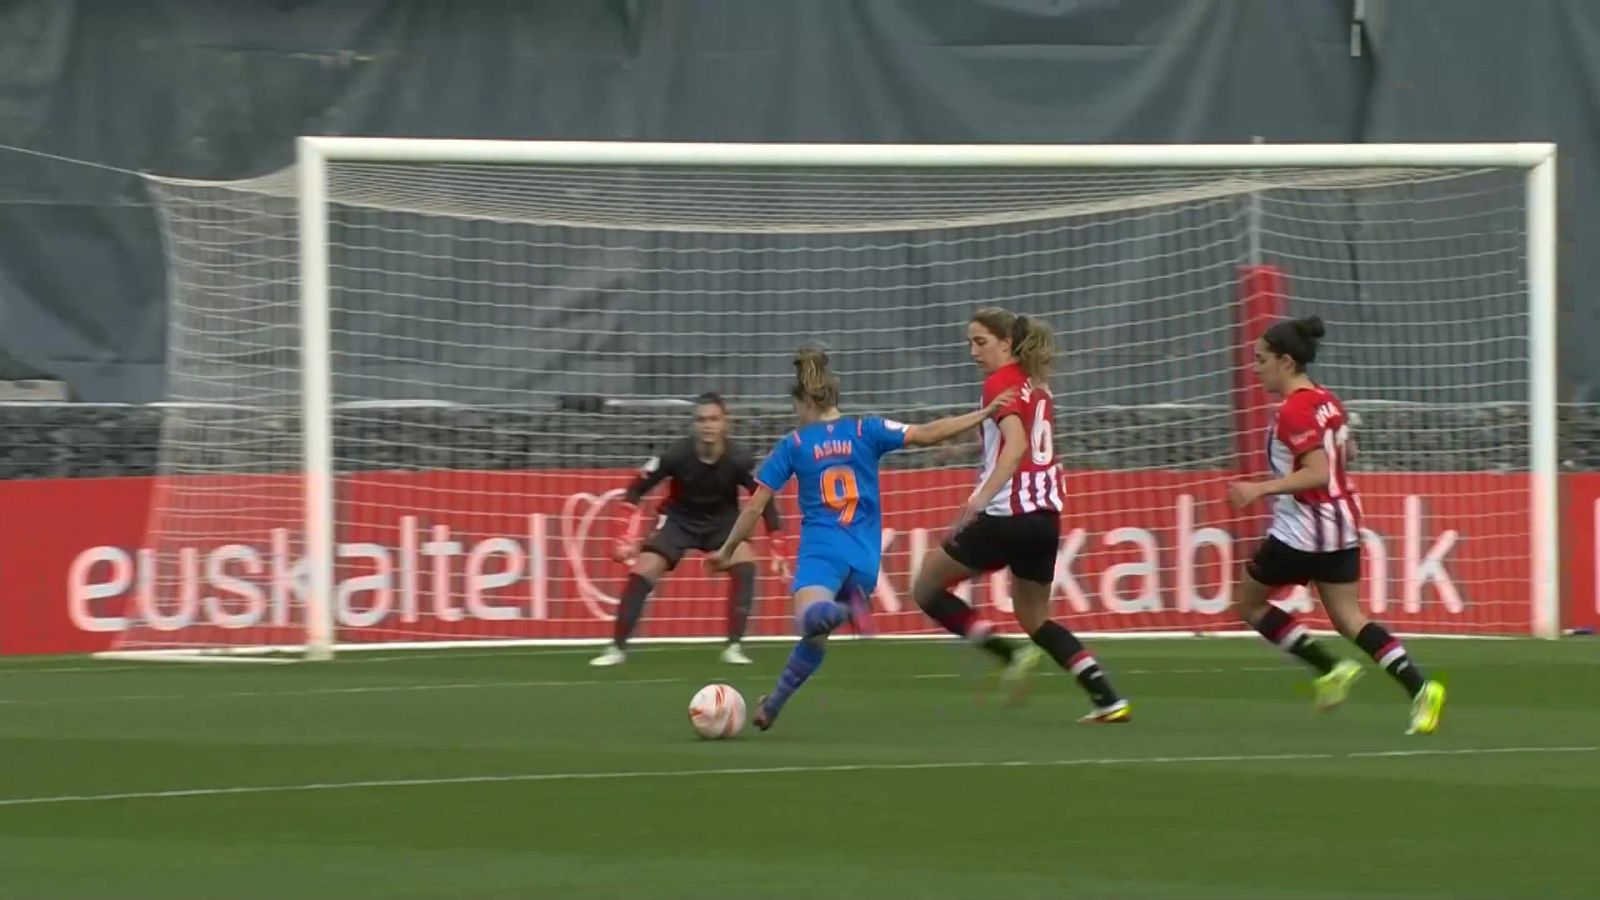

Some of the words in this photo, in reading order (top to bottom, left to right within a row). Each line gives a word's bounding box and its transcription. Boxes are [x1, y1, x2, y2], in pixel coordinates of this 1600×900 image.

[814, 439, 853, 461] ASUN
[1031, 399, 1054, 466] 6
[820, 465, 859, 525] 9
[67, 512, 548, 632] euskaltel
